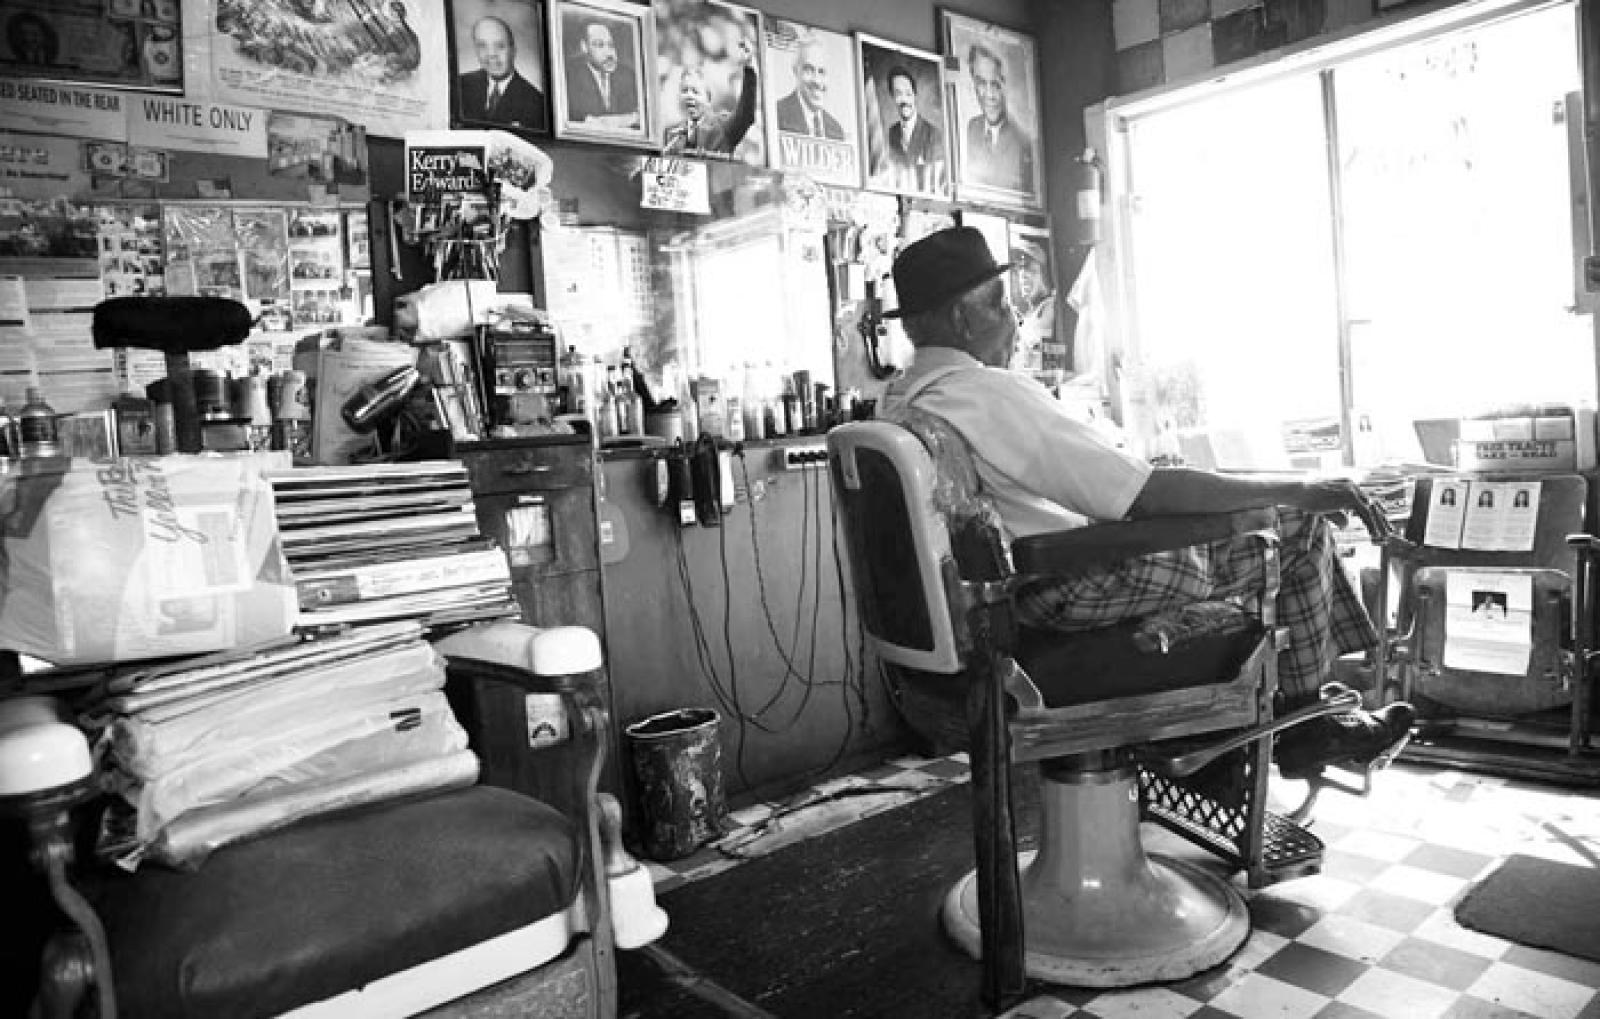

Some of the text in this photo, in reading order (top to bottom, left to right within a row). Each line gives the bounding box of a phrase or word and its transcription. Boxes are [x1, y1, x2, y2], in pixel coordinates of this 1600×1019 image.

[17, 83, 57, 104] SEATED
[59, 88, 72, 106] IN
[73, 90, 92, 109] THE
[94, 94, 120, 113] REAR
[143, 98, 253, 132] WHITE ONLY
[411, 150, 457, 176] Kerry
